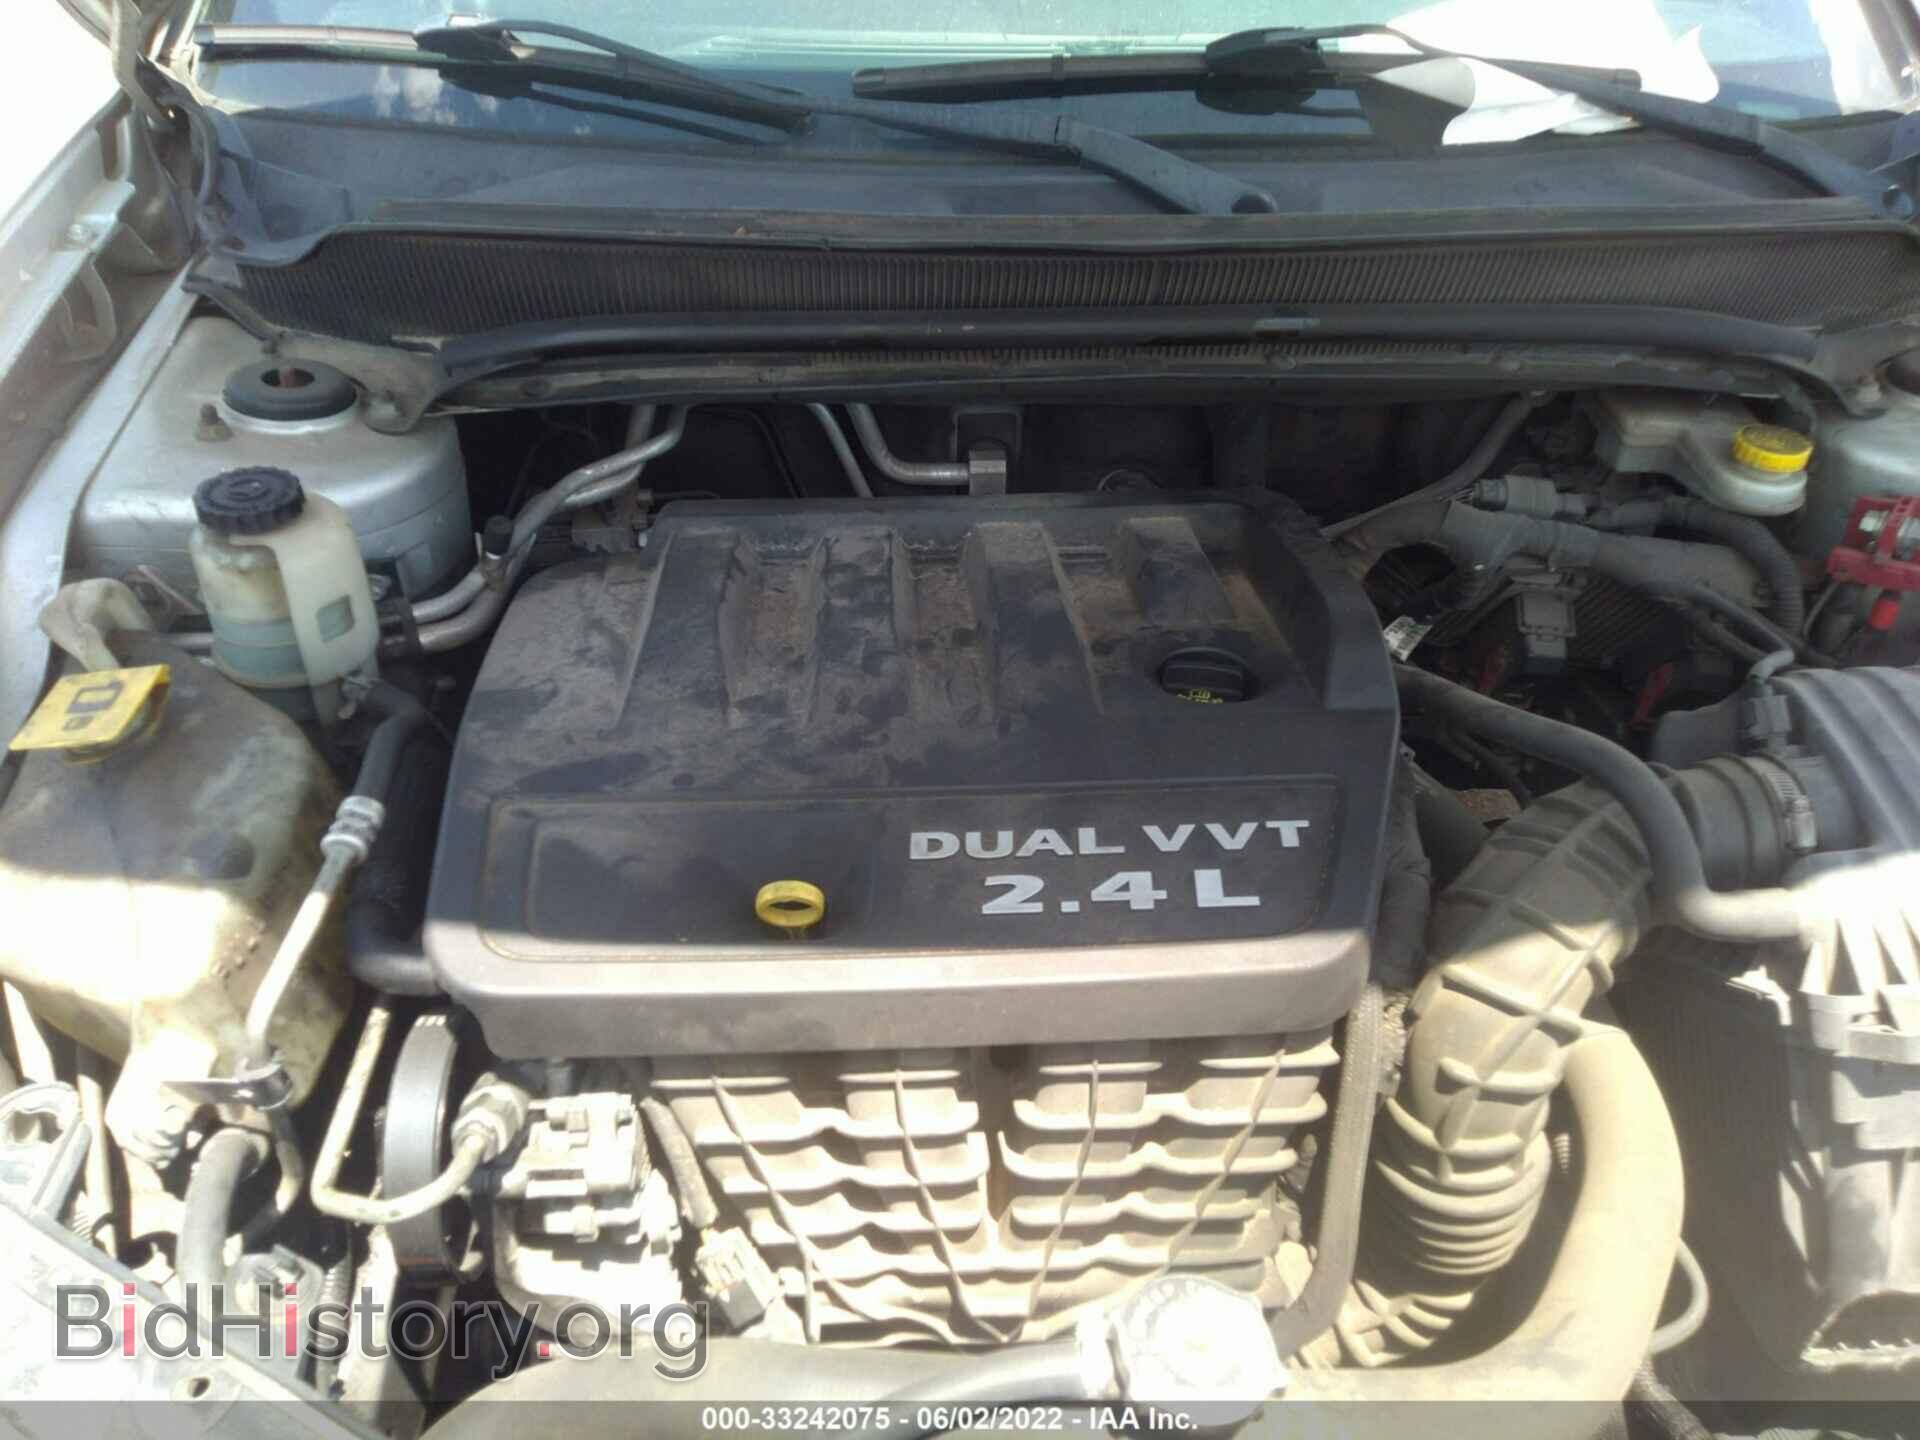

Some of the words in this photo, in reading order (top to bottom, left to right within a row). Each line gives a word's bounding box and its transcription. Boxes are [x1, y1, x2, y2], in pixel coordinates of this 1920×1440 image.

[909, 827, 1126, 860] DUAL
[1141, 819, 1311, 853] VVT
[981, 870, 1169, 915] 2.4
[1194, 868, 1261, 909] L
